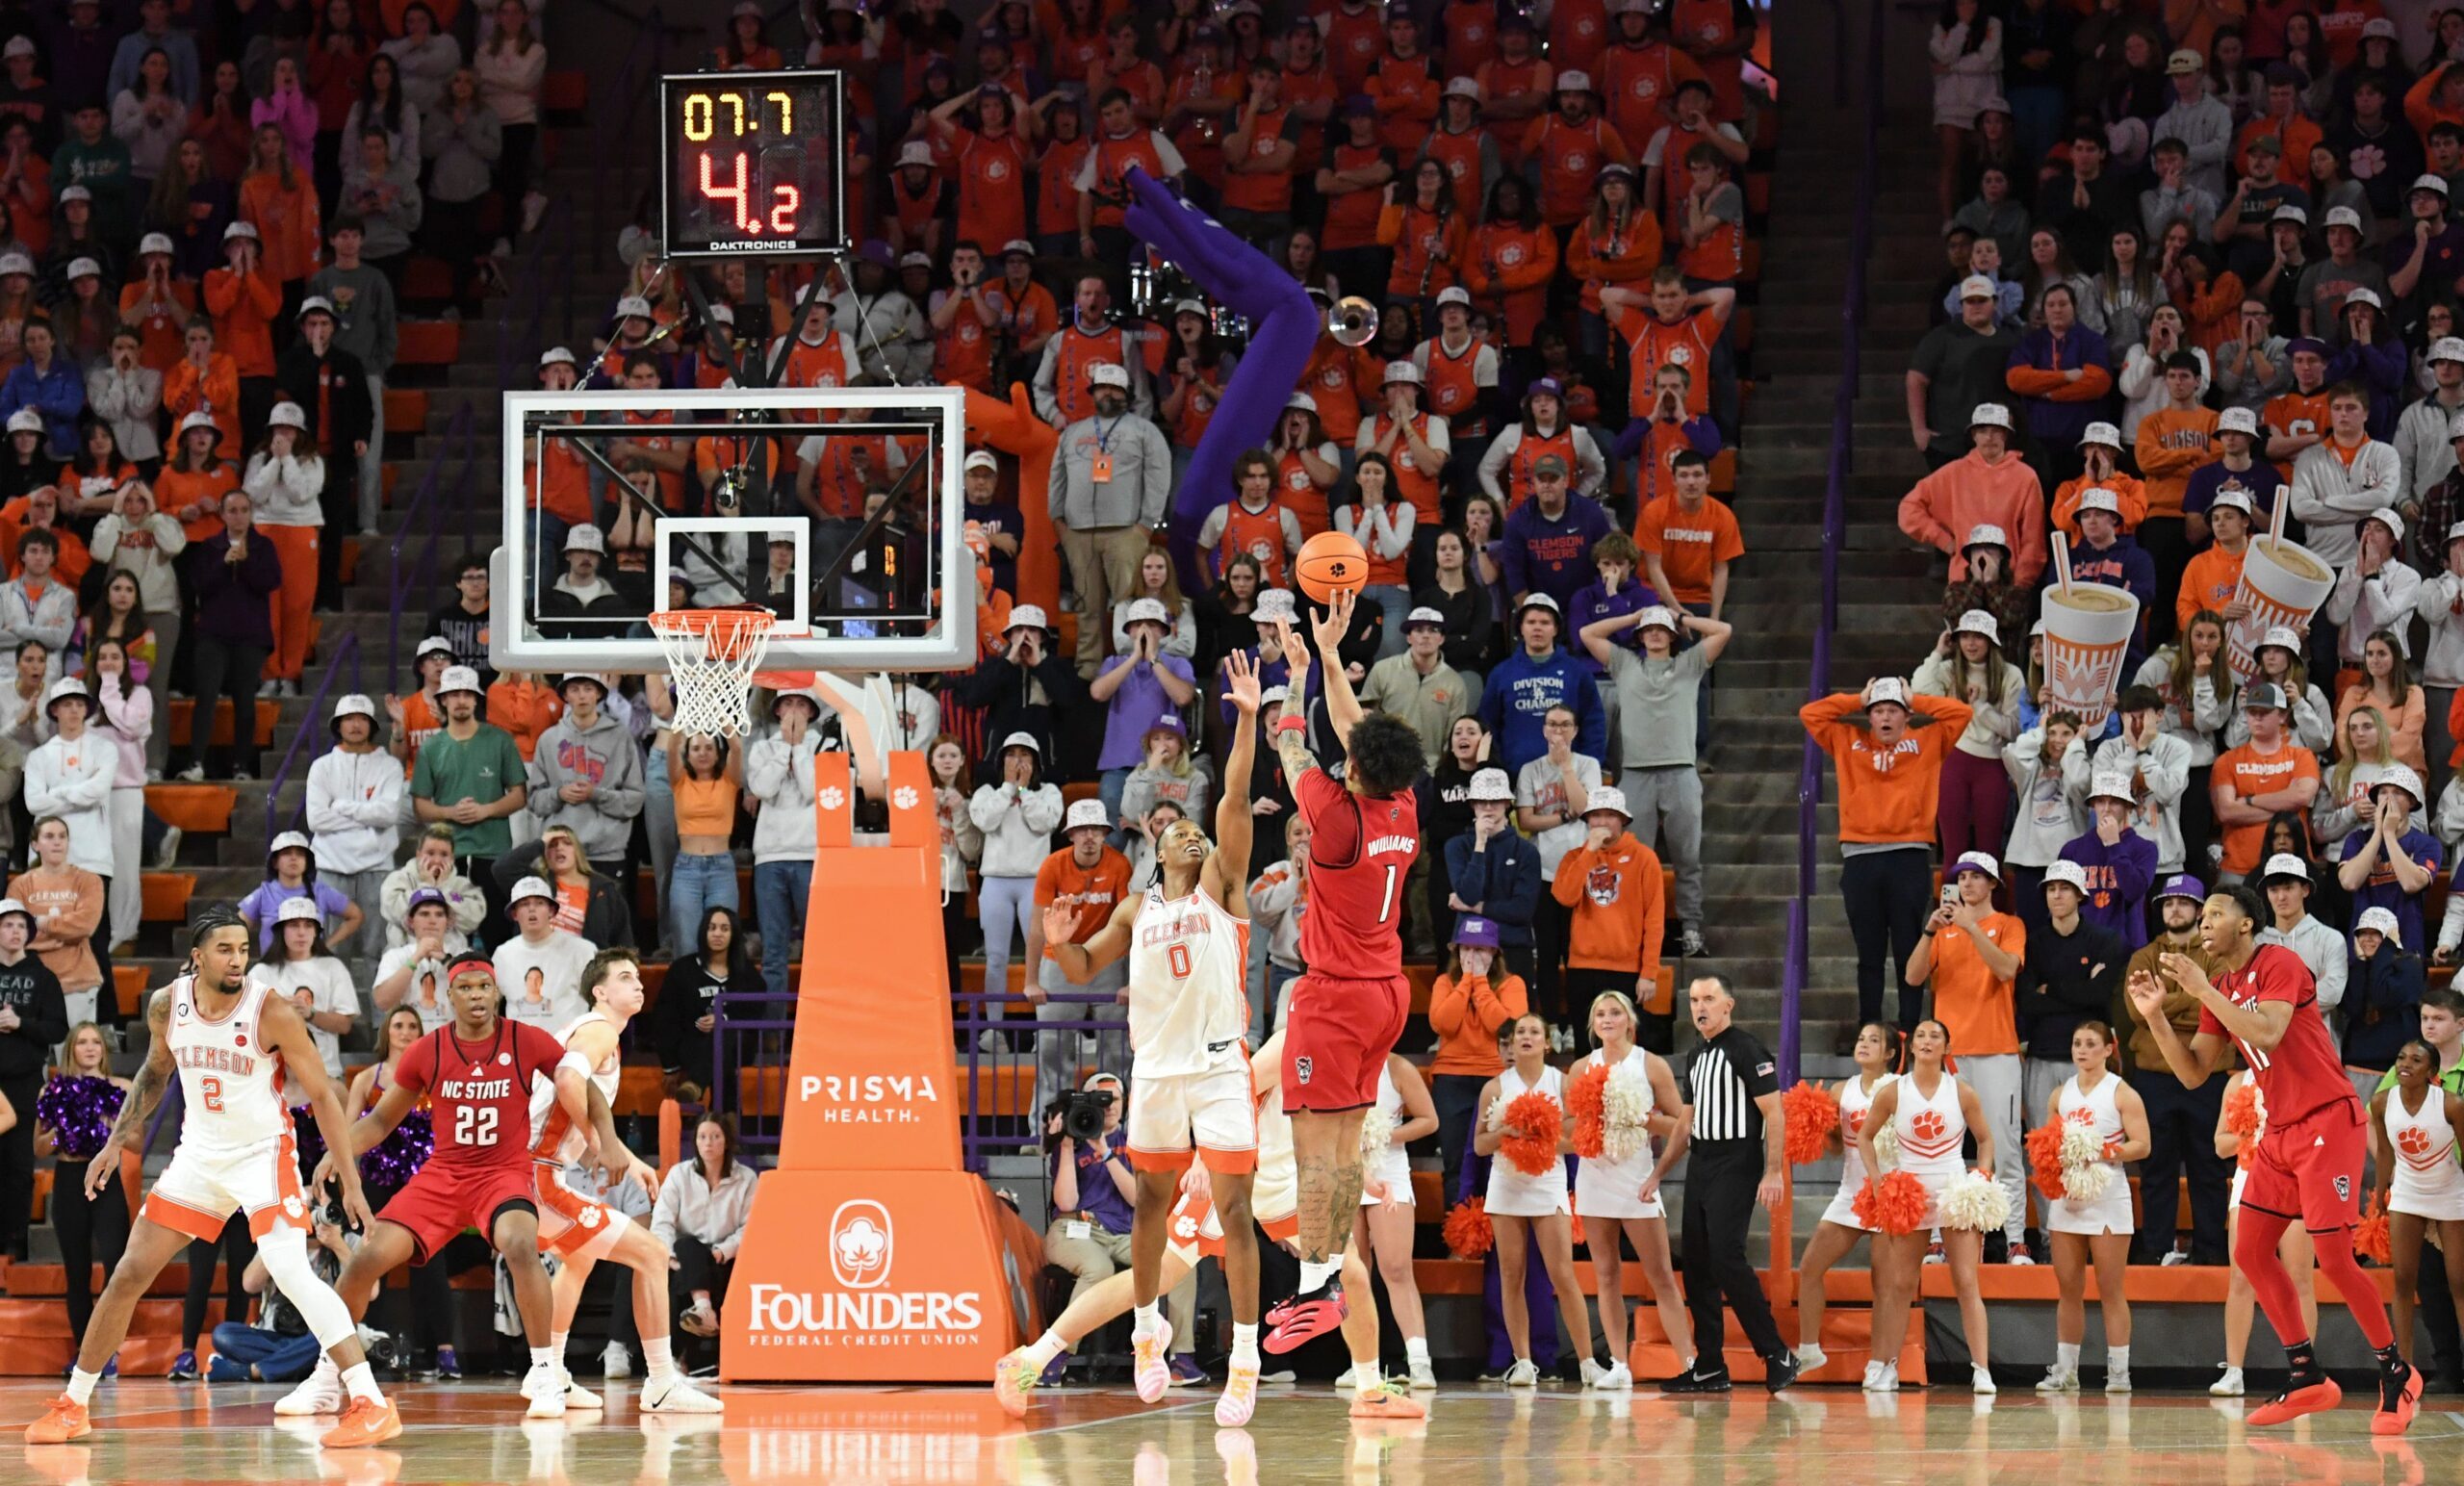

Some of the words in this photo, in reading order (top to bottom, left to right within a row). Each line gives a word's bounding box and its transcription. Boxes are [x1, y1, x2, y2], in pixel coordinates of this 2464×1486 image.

[684, 92, 791, 141] 07.7
[709, 241, 797, 252] DAKTRONICS
[1527, 535, 1584, 551] CLEMSON
[1535, 547, 1578, 561] TIGERS
[1513, 677, 1564, 691] DIVISION
[2237, 760, 2296, 776] CLEMSON
[1368, 834, 1415, 858] WILLIAMS
[1378, 864, 1396, 924] 1
[1142, 912, 1211, 947] CLEMSON
[1166, 941, 1193, 980] 0
[201, 1075, 225, 1114] 2
[441, 1080, 464, 1099] NC
[464, 1077, 511, 1099] STATE
[801, 1075, 937, 1102] PRISMA
[454, 1103, 499, 1147] 22
[749, 1283, 982, 1332] FOUNDERS
[749, 1334, 834, 1346] FEDERAL
[841, 1334, 911, 1348] CREDIT
[920, 1334, 980, 1347] UNION
